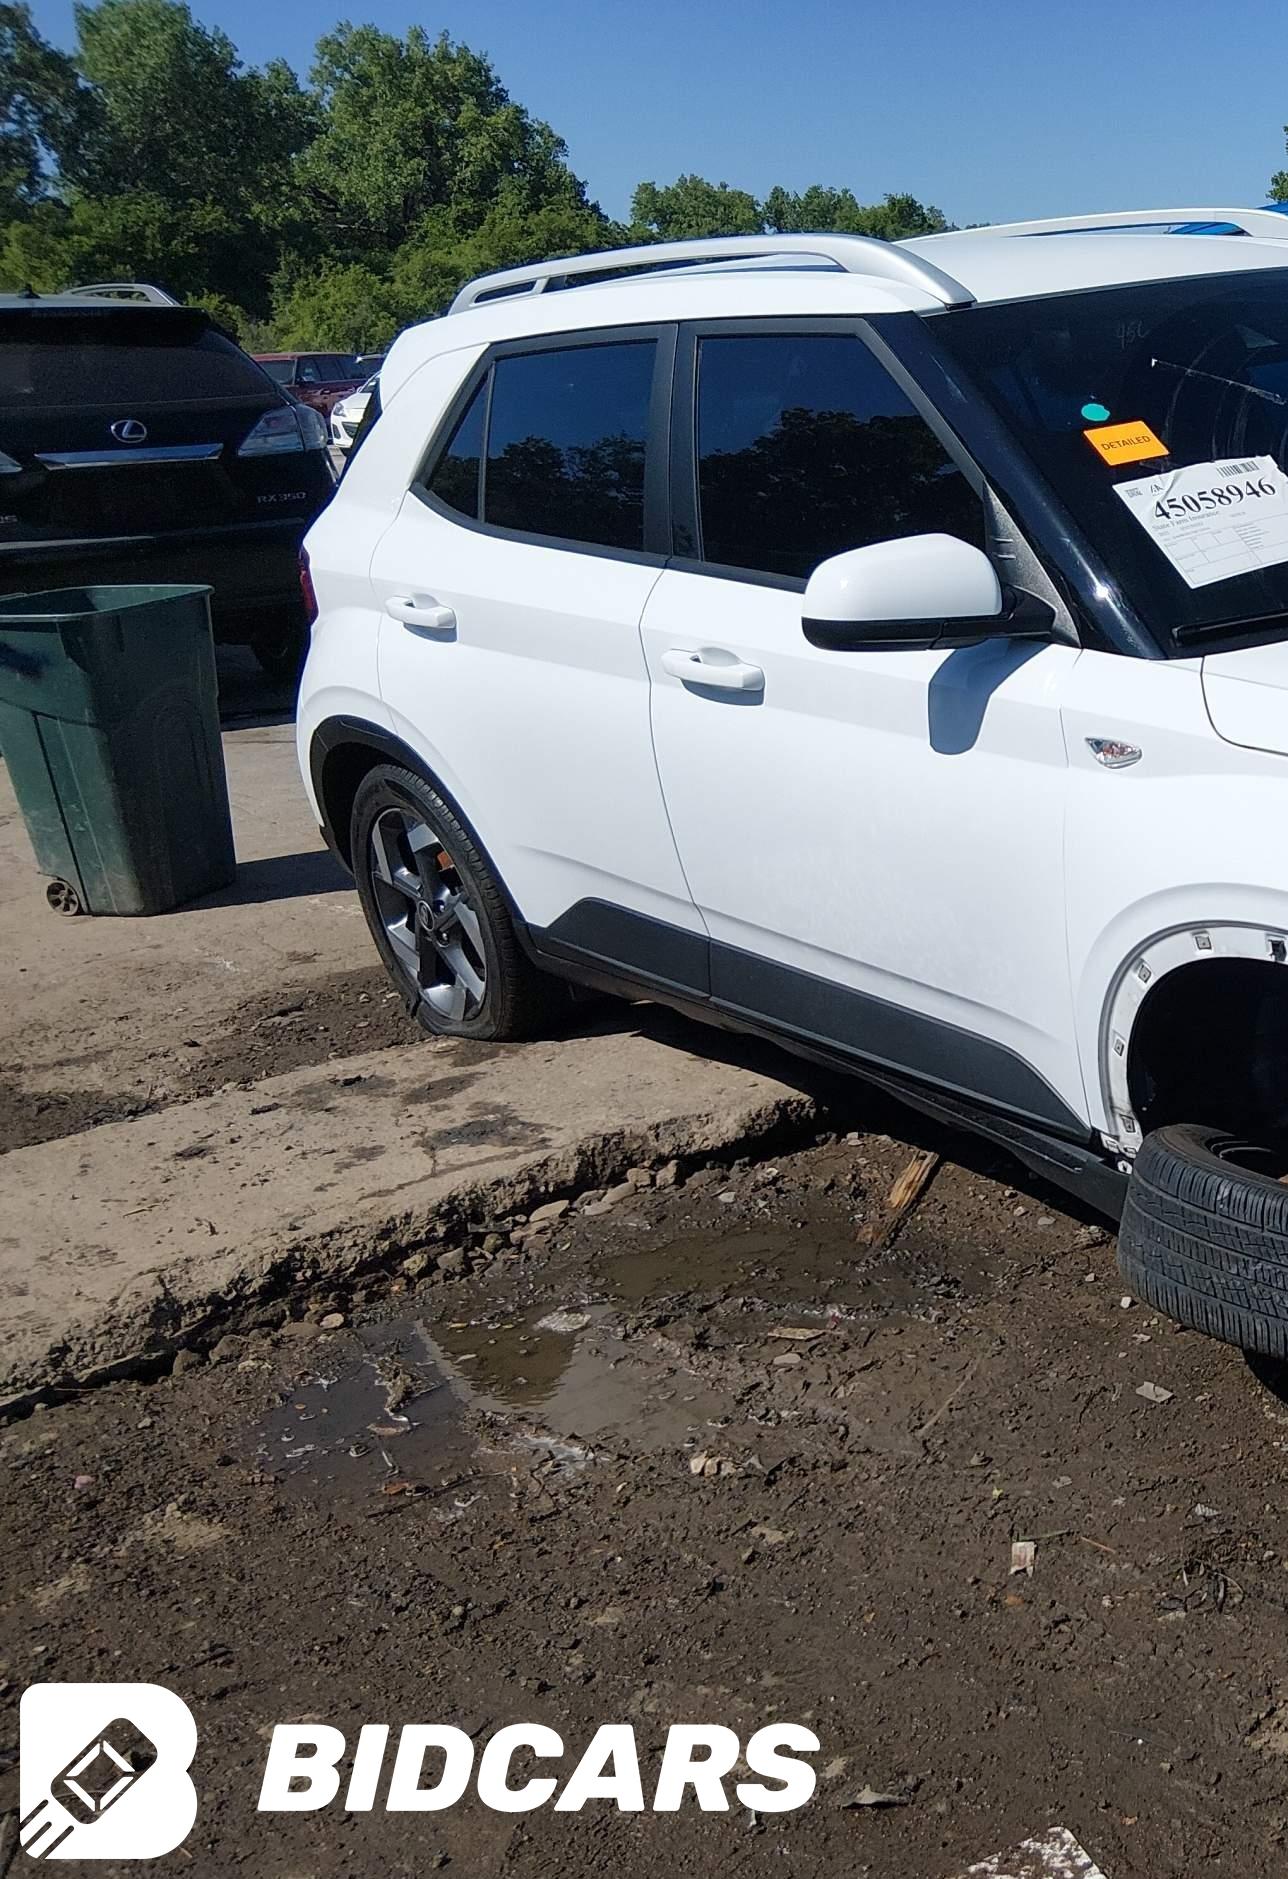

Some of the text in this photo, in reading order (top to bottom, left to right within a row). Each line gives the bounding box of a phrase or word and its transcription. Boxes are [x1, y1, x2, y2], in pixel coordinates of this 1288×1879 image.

[1101, 434, 1151, 451] DETAILED
[256, 495, 277, 503] RX
[1154, 476, 1276, 520] 45058946
